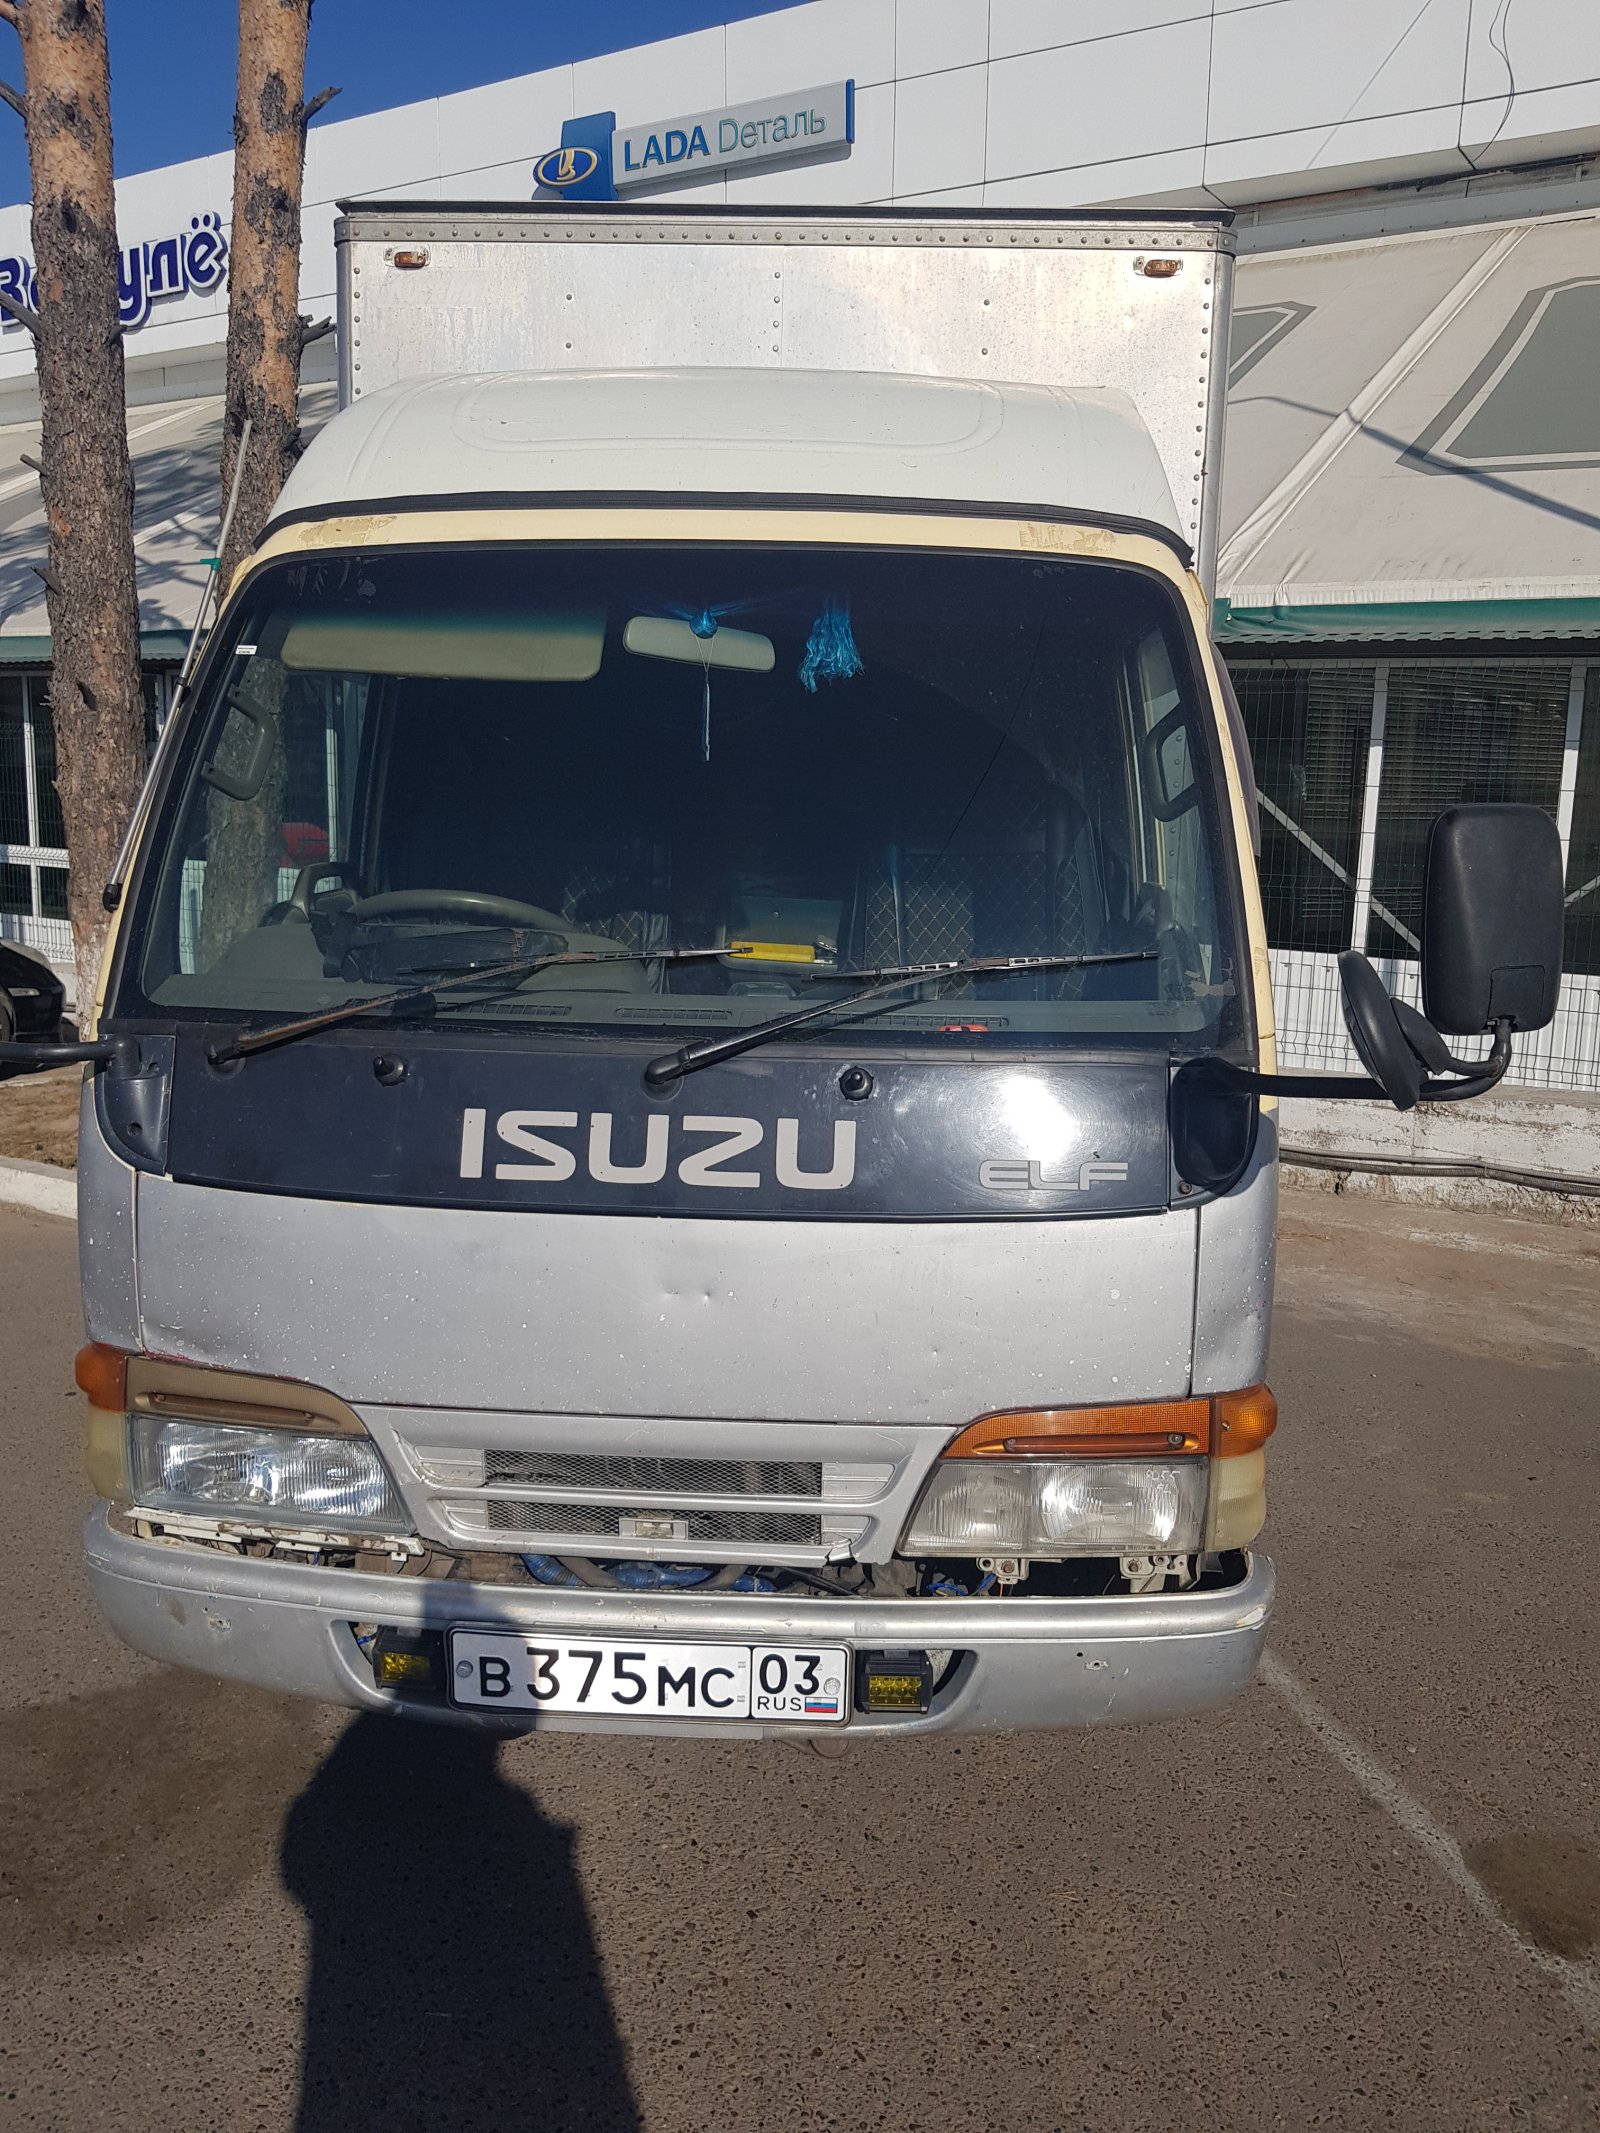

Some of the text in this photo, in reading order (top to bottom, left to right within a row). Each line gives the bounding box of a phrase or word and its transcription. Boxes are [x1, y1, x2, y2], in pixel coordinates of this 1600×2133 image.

[624, 125, 711, 172] LADA
[117, 211, 223, 326] улё
[459, 1107, 857, 1189] ISUZU
[980, 1159, 1129, 1191] ELF
[759, 1653, 821, 1696] 03
[757, 1695, 802, 1712] RUS
